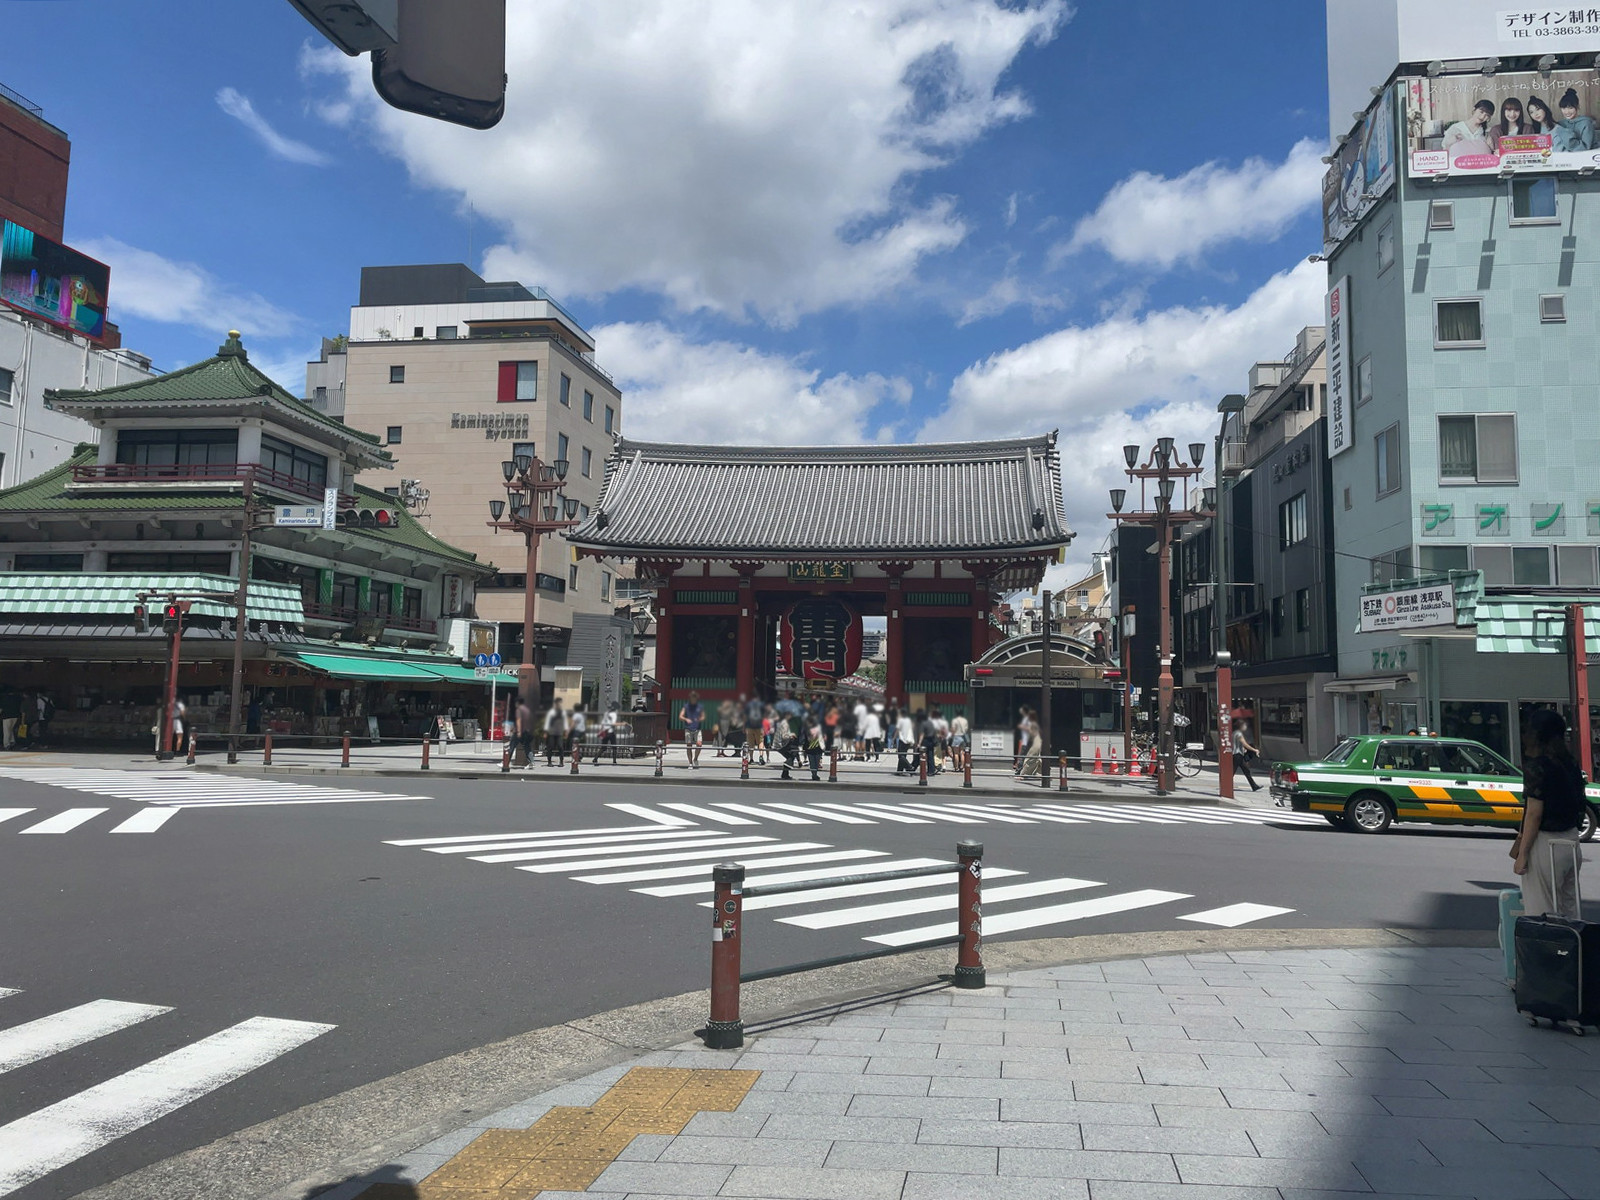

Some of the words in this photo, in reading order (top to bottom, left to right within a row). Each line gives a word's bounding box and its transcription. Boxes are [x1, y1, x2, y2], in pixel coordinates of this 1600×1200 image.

[1504, 9, 1600, 27] デザイン制作
[1512, 29, 1531, 38] TEL
[1535, 25, 1600, 37] 03-3863-39
[451, 412, 529, 428] Kaminarimon
[1425, 503, 1600, 531] アオノ
[1363, 599, 1382, 610] 地下鉄
[1396, 594, 1418, 606] 銀座線
[1420, 590, 1443, 603] 浅草駅
[1363, 609, 1382, 617] SUBWAY
[1396, 606, 1409, 614] Ginza
[1420, 603, 1441, 611] Asakusa
[788, 598, 851, 678] 雷門
